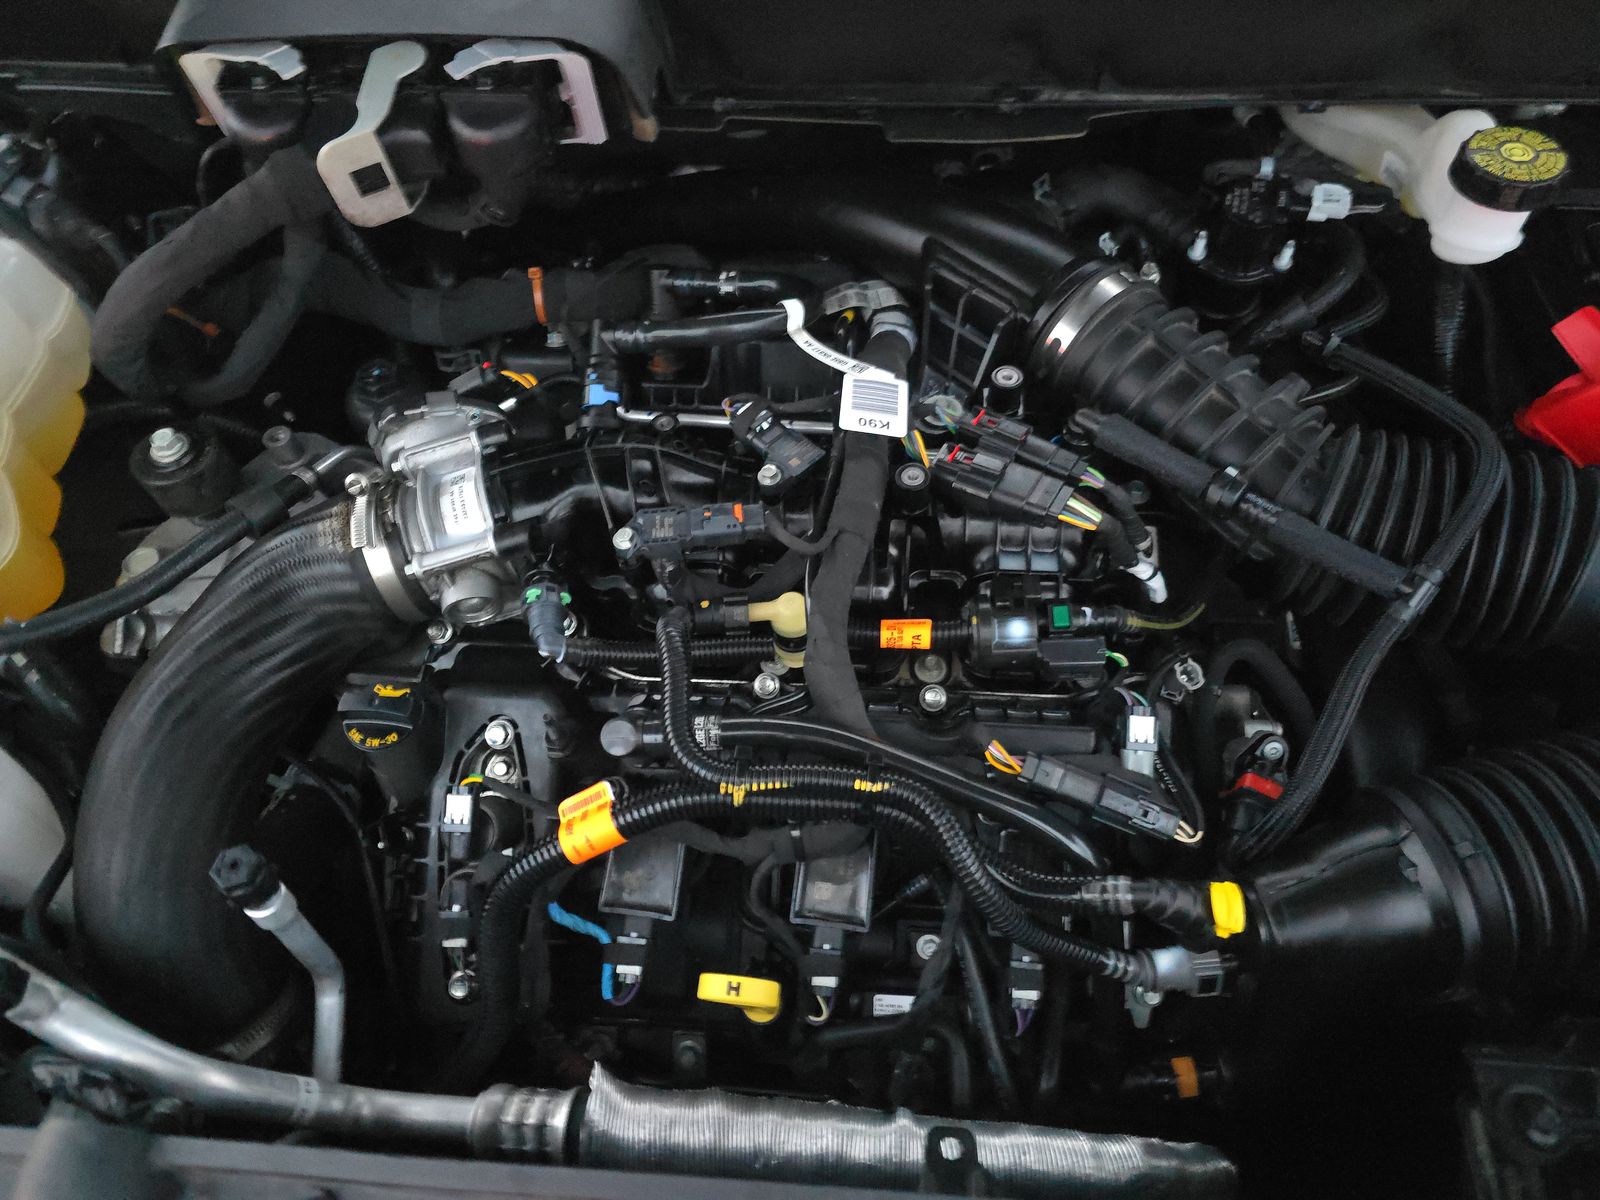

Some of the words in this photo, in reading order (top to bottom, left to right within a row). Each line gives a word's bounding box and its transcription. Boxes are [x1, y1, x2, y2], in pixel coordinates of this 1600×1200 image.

[858, 417, 890, 430] K90
[348, 727, 364, 744] SAE
[365, 732, 398, 747] 5W-30
[727, 980, 741, 997] H
